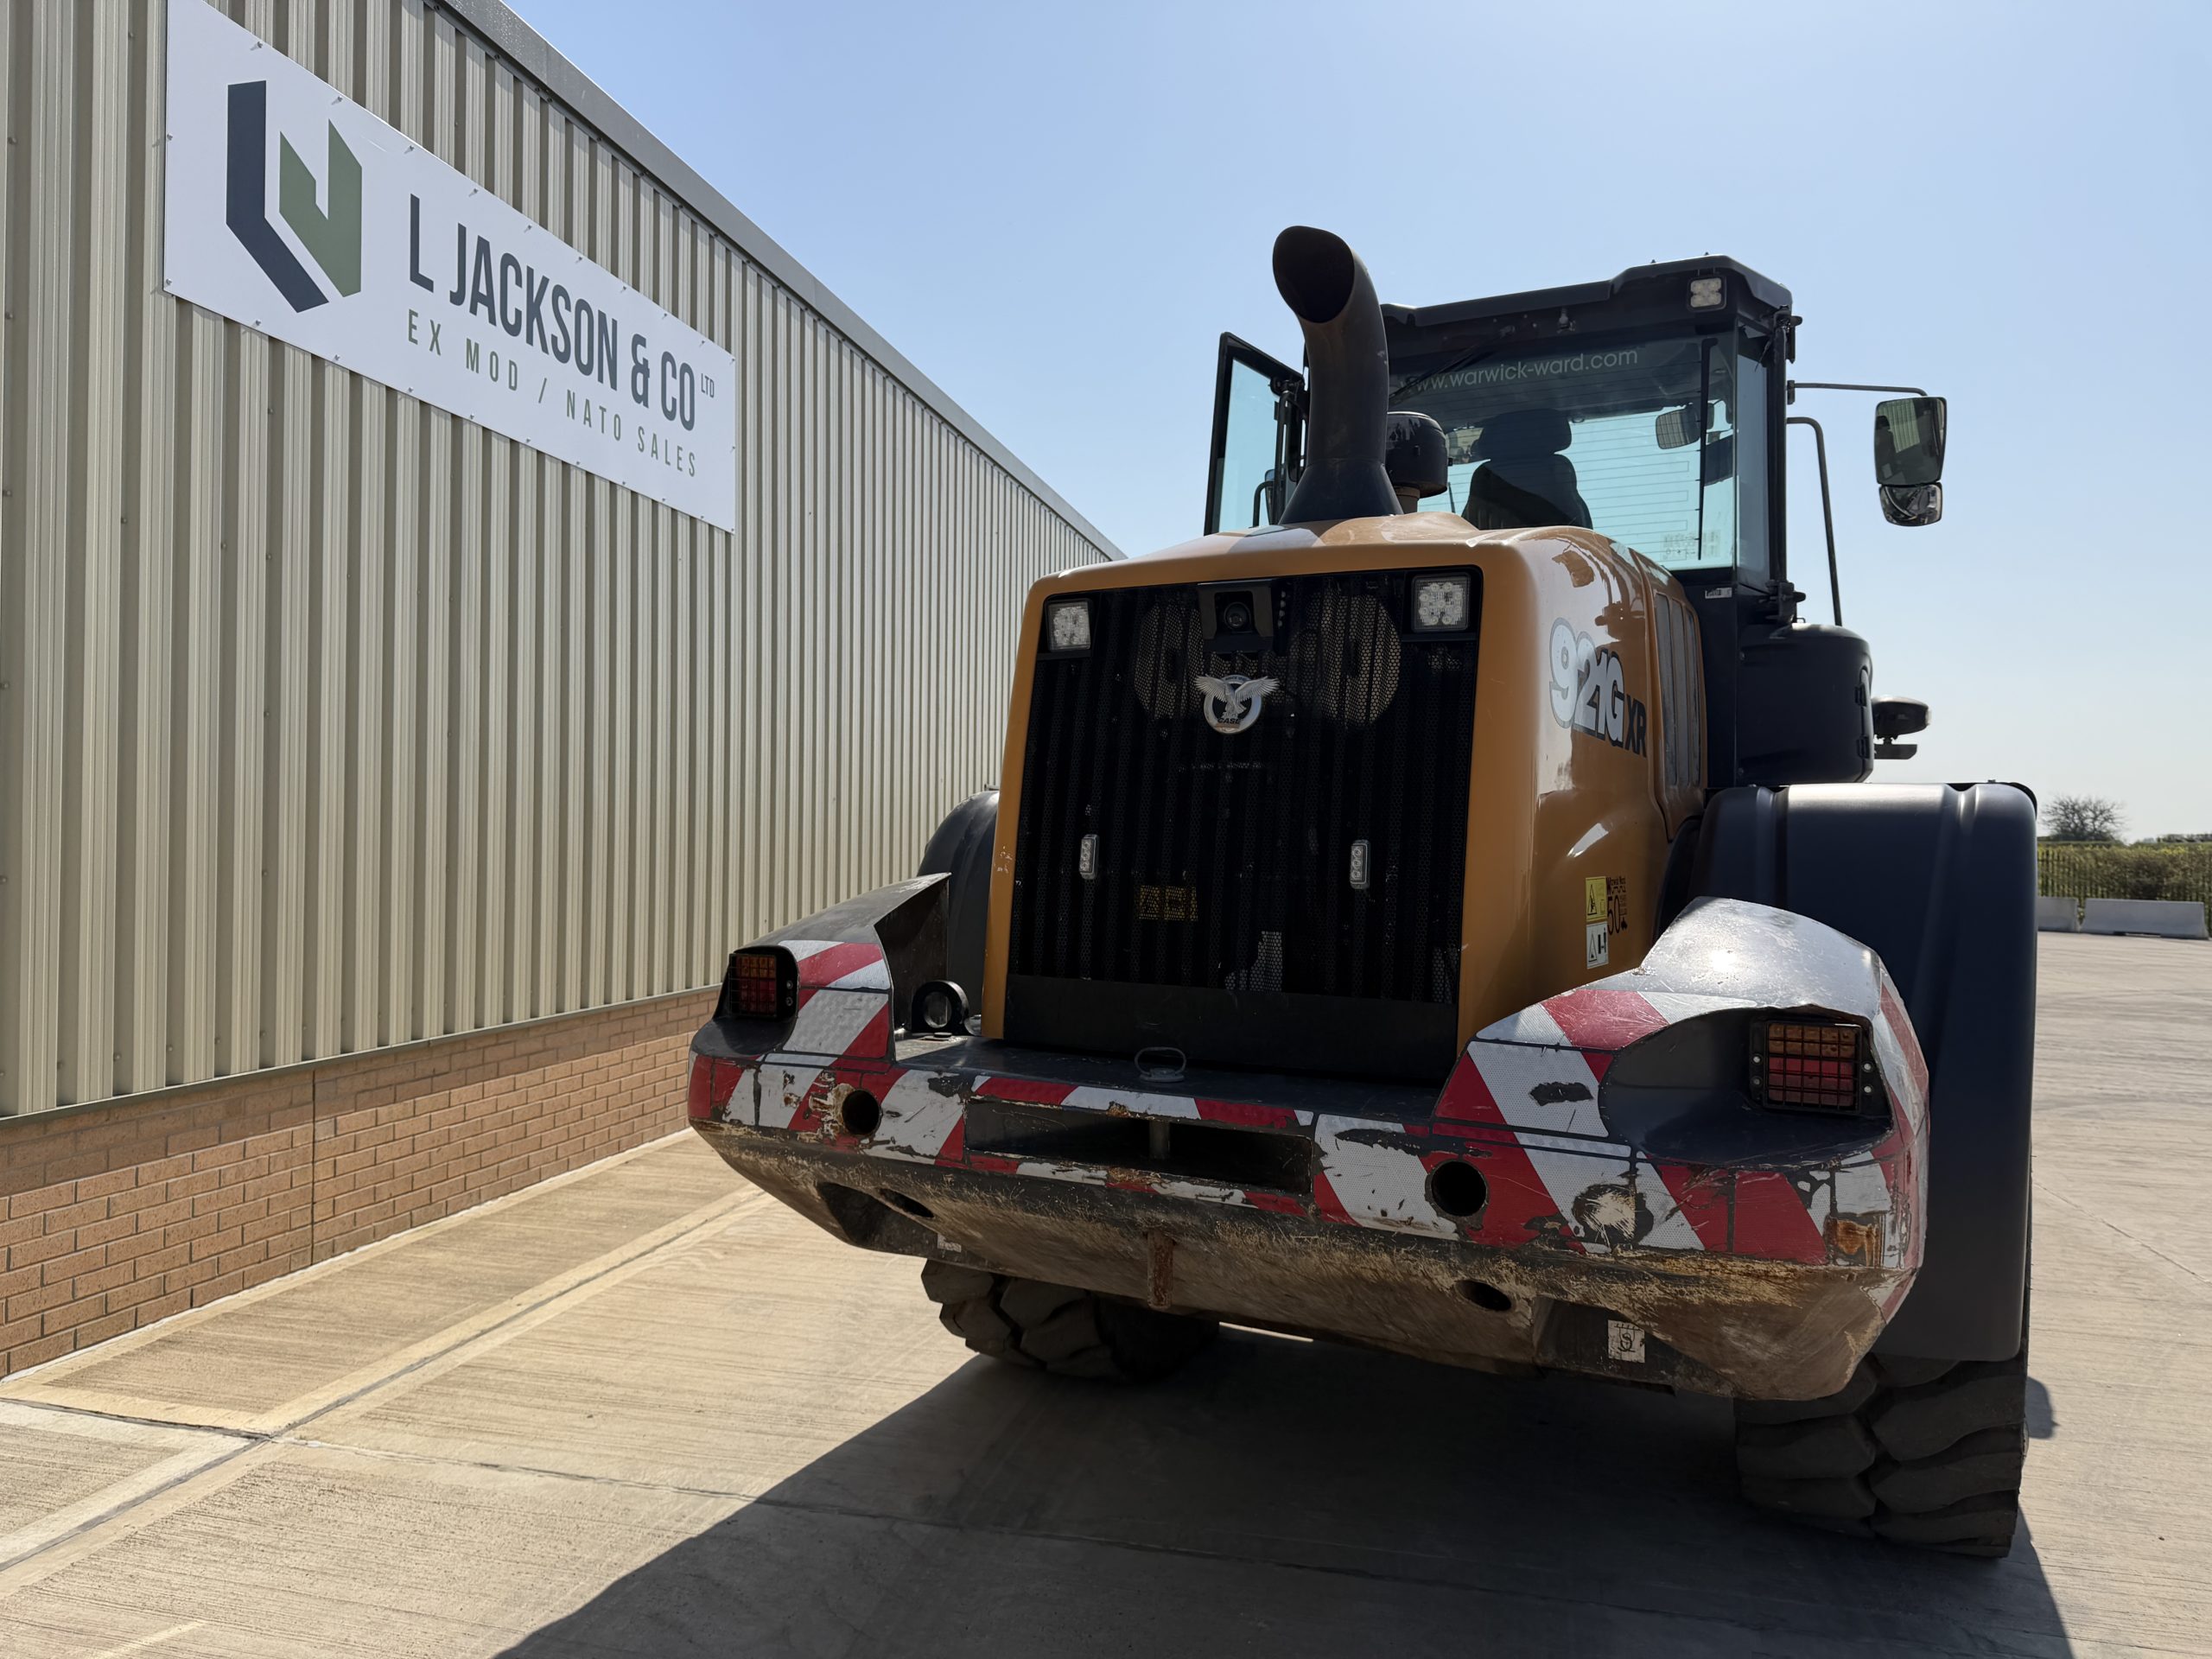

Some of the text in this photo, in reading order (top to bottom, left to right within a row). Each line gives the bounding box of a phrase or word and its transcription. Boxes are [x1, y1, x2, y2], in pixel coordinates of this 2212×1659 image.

[410, 193, 715, 431] L JACKSON & CO LTD
[408, 308, 696, 478] EX MOD / NATO SALES
[1625, 693, 1647, 758] XR
[1607, 894, 1621, 935] 50
